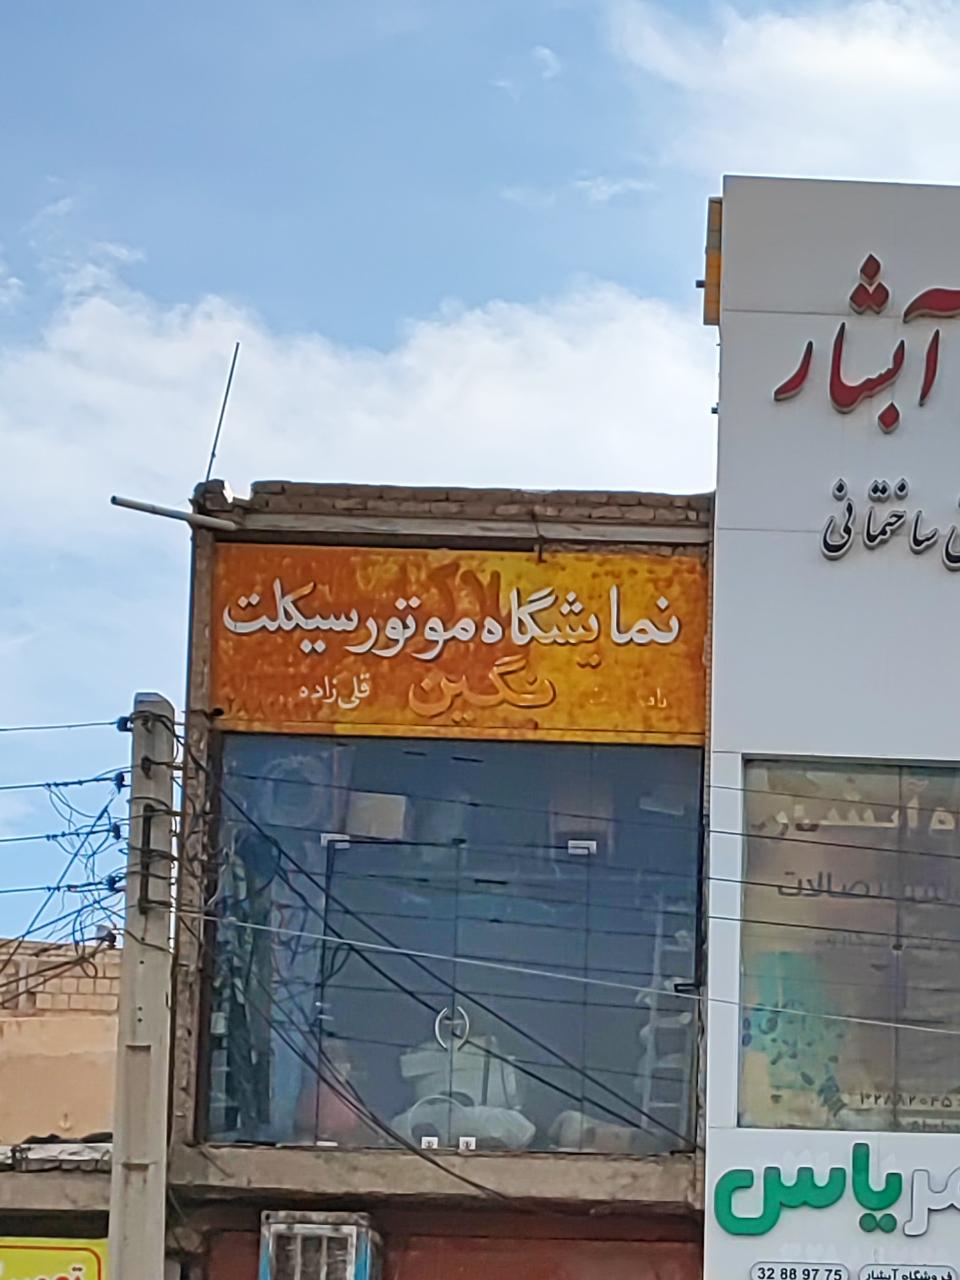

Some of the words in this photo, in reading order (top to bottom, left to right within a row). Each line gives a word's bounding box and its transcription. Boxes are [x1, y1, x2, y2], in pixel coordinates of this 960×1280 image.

[821, 479, 938, 560] ساختمانی
[481, 584, 680, 668] نمایشگاه
[714, 1142, 902, 1237] یاس
[757, 1267, 775, 1280] 32
[780, 1267, 797, 1280] 88
[802, 1268, 820, 1280] 97
